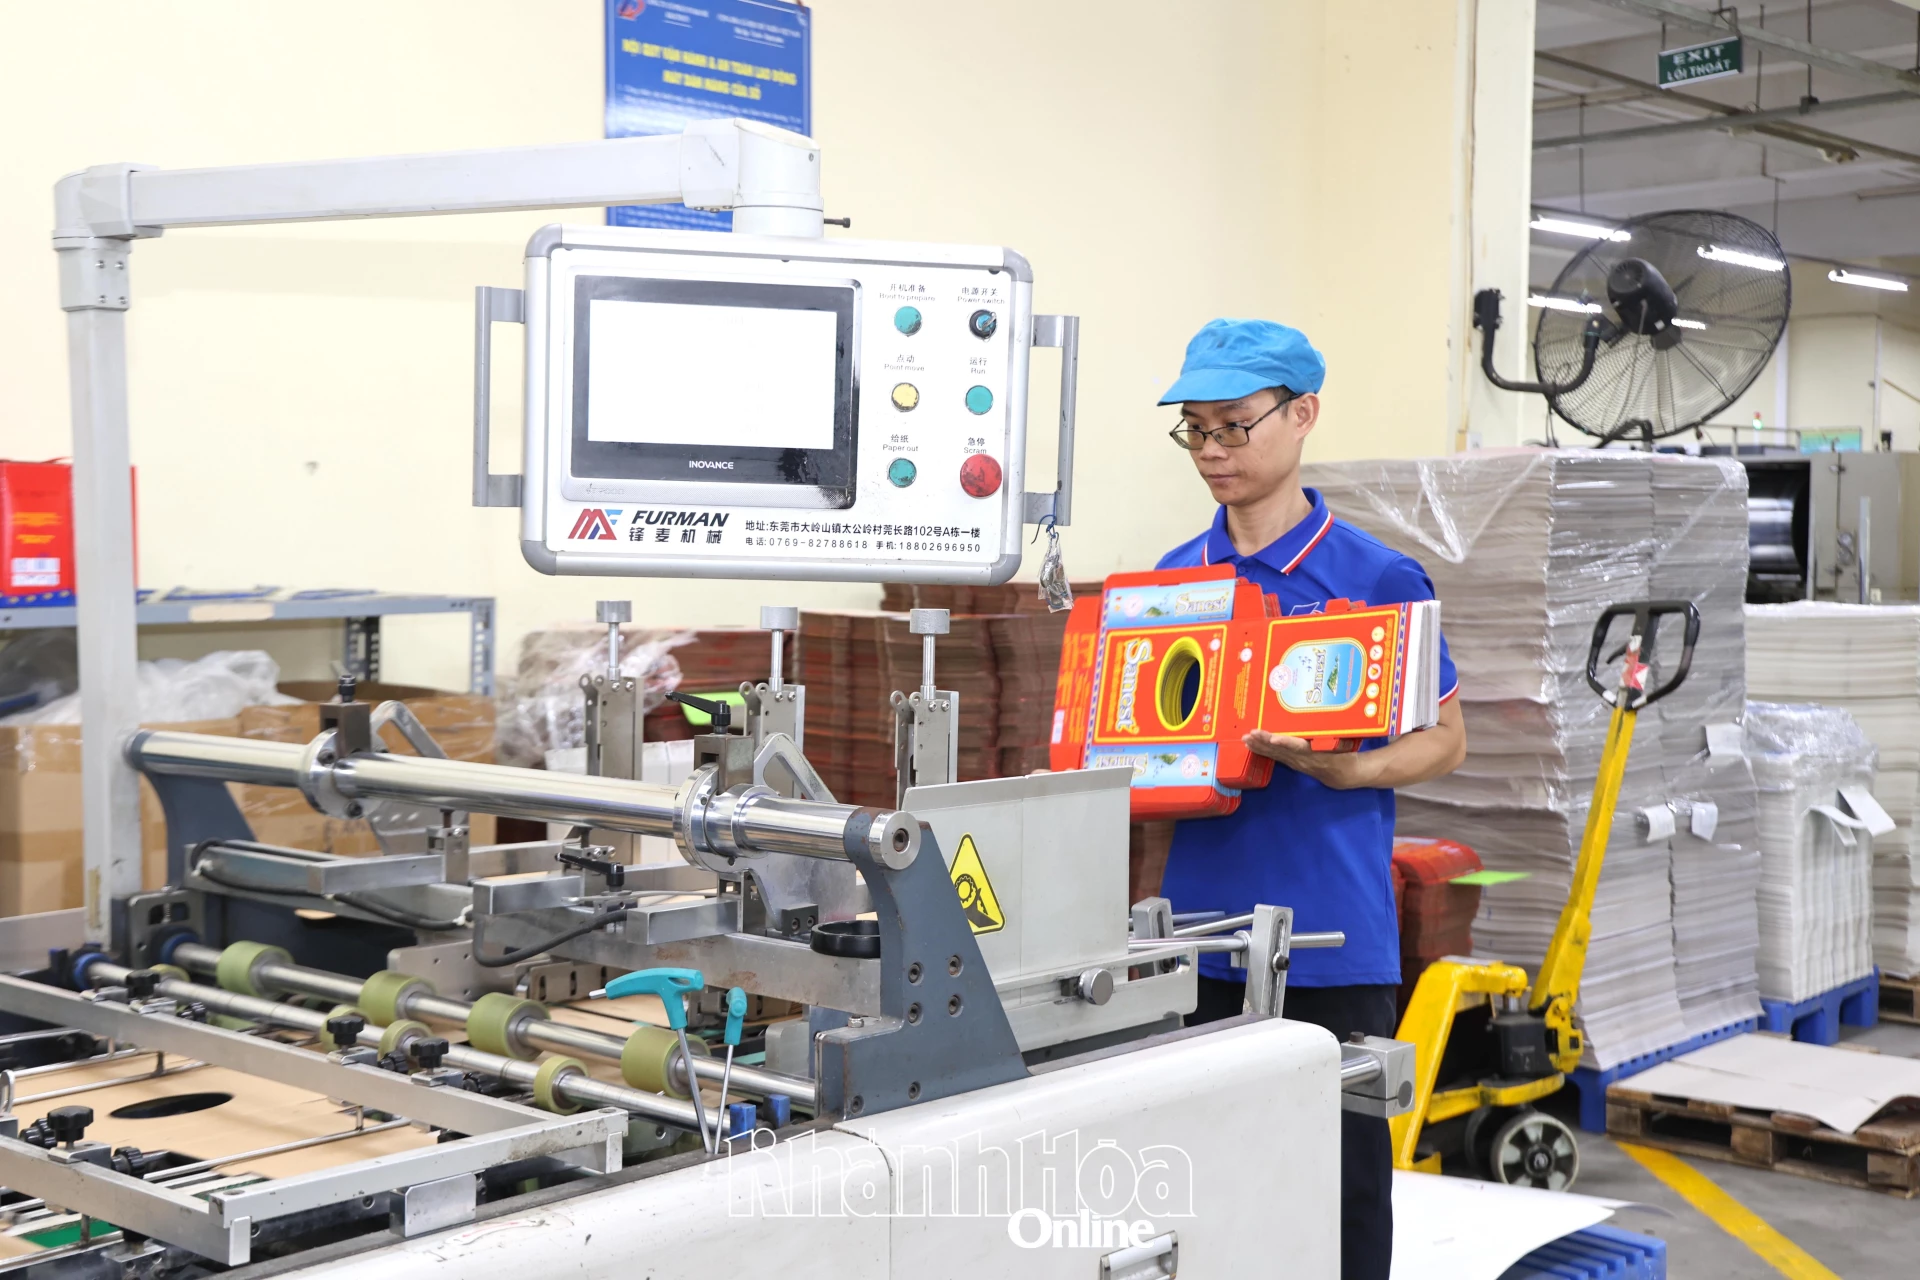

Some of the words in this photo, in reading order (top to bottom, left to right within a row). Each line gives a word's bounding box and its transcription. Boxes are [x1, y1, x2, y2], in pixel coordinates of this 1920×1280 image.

[1673, 44, 1724, 66] EXIT
[961, 286, 998, 296] 电源开关
[957, 295, 981, 303] Power
[982, 297, 1005, 305] switch
[896, 354, 915, 363] 点动
[969, 357, 988, 366] 运行
[884, 363, 904, 371] Point
[904, 364, 925, 372] move
[970, 367, 986, 375] Run
[890, 434, 909, 443] 给纸
[967, 437, 985, 446] 急停
[882, 444, 905, 452] Paper
[689, 460, 734, 470] INOVANCE
[631, 510, 730, 527] FURMAN
[628, 527, 723, 544] 锋麦机械
[1175, 591, 1230, 617] Sanest
[1306, 647, 1326, 704] Sanest
[1115, 637, 1154, 734] Sanest
